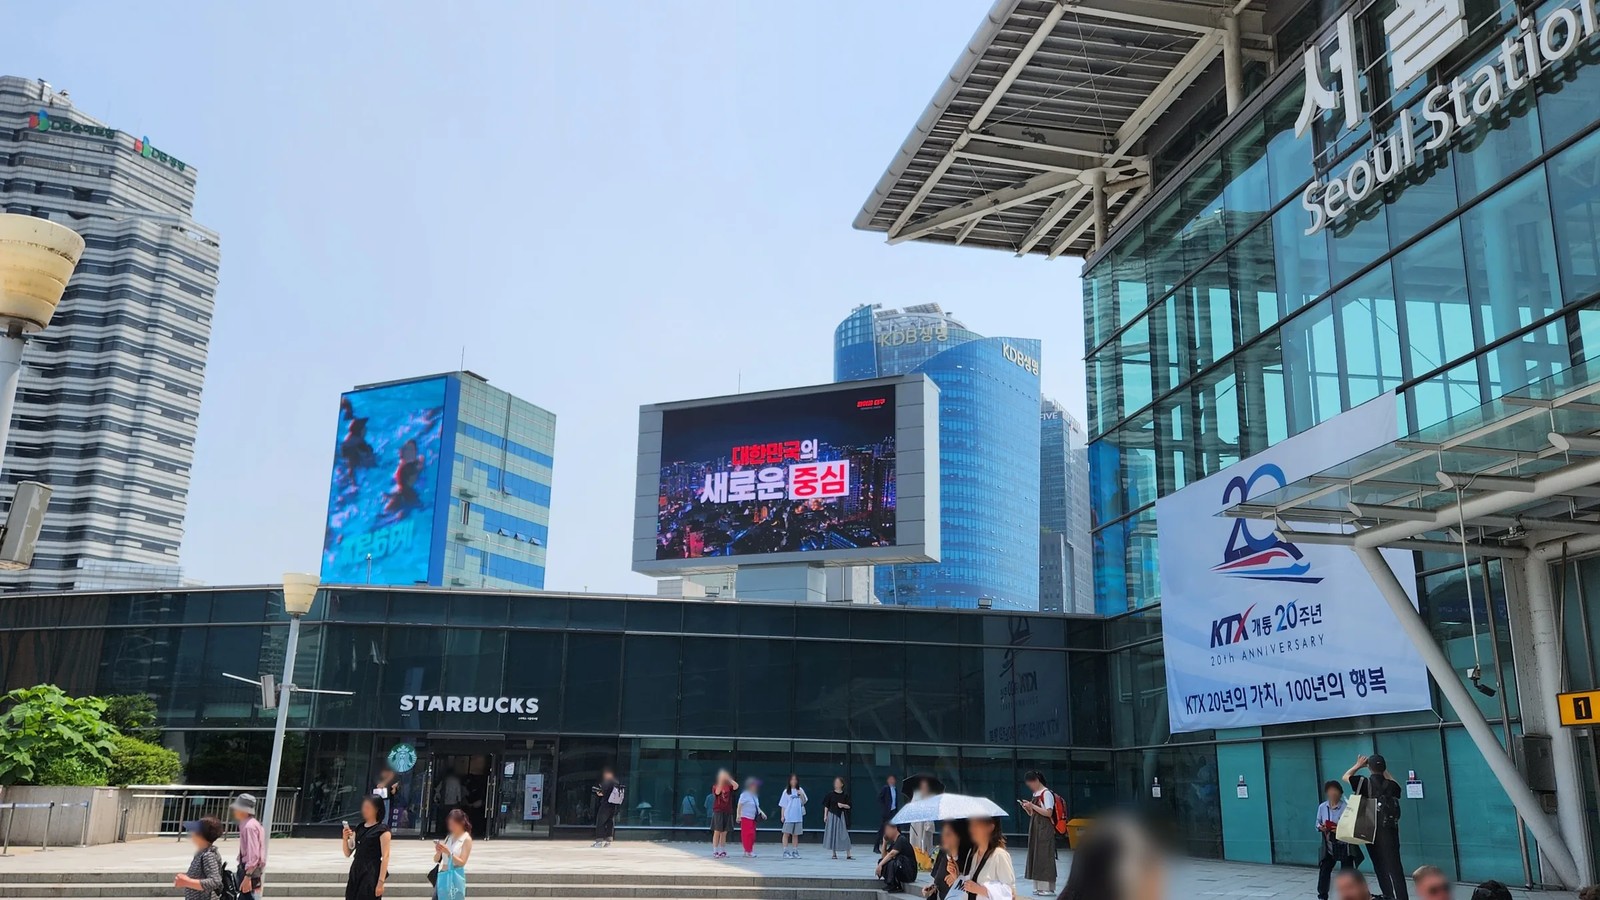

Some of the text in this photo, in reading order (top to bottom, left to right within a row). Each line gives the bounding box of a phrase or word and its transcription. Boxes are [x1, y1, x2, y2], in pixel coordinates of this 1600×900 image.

[1302, 108, 1415, 236] Seoul
[879, 322, 948, 347] KDB생명
[1002, 342, 1039, 376] KDB생명
[731, 438, 818, 466] 대한민국의
[700, 463, 845, 504] 새로운 중심
[1210, 603, 1257, 648] KTX
[1252, 616, 1272, 637] 개통
[1211, 633, 1325, 666] 20th ANNIVERSARY
[400, 694, 539, 714] STARBUCKS
[1185, 666, 1387, 715] KTX 20년의 가치, 100년의 행복
[1578, 700, 1586, 717] 1
